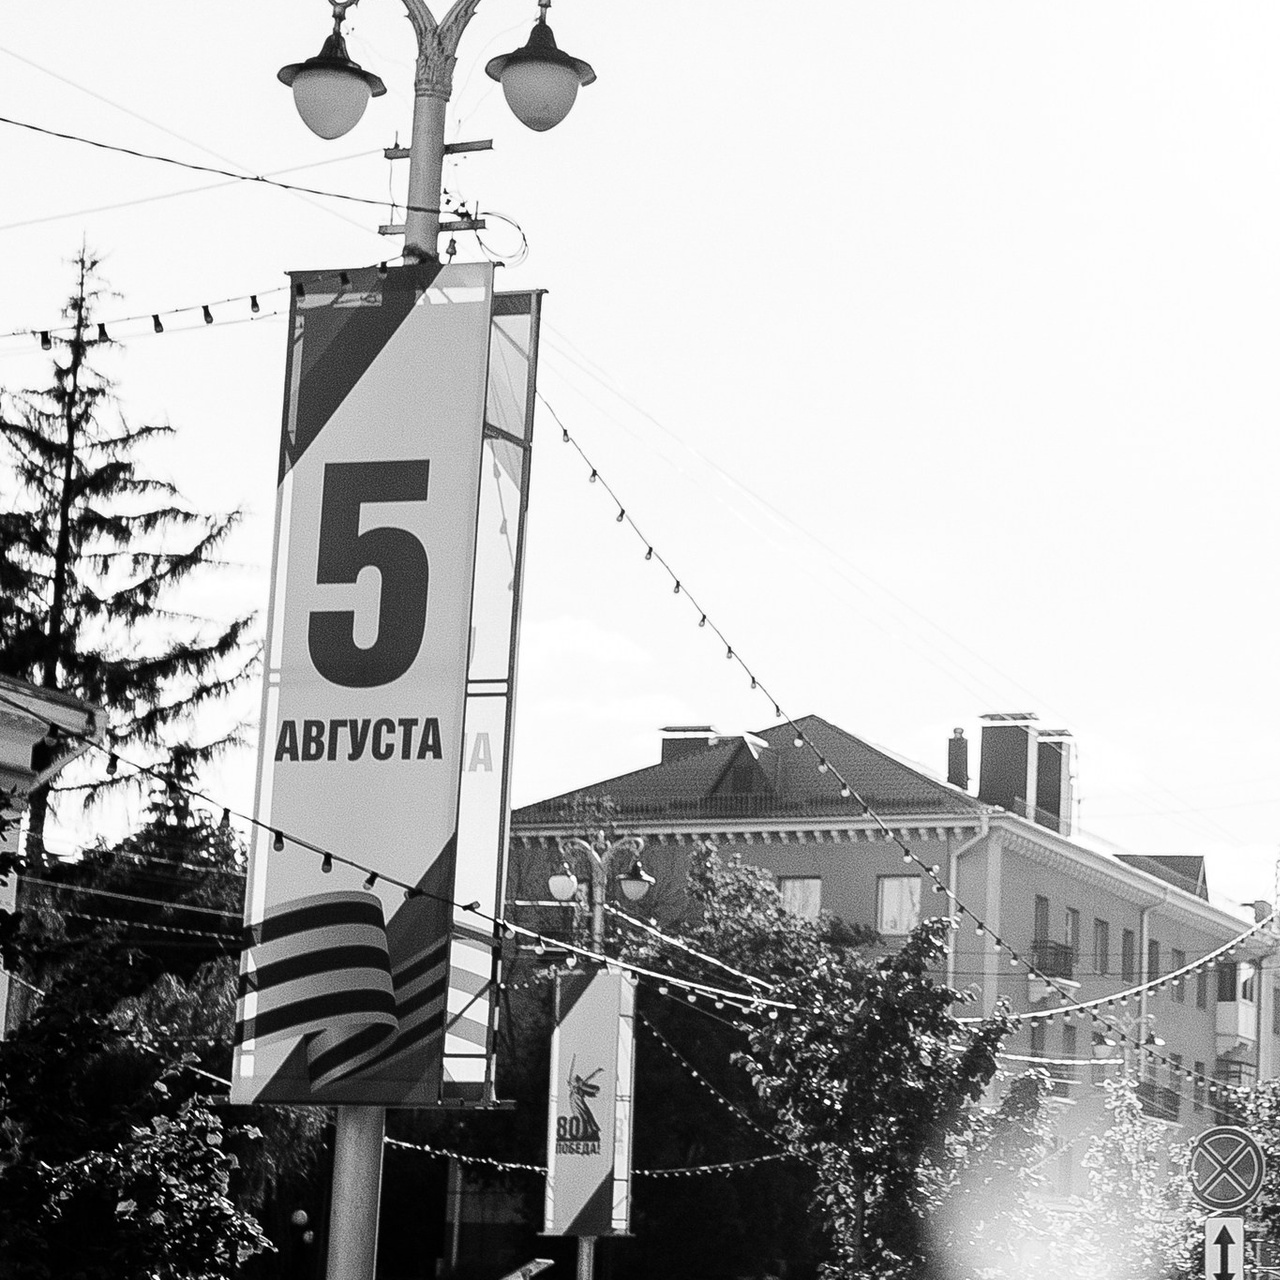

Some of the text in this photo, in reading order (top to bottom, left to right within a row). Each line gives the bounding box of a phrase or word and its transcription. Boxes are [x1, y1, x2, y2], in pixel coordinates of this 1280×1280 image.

[308, 459, 430, 688] 5
[274, 717, 443, 762] АВГУСТА
[557, 1116, 581, 1140] 80
